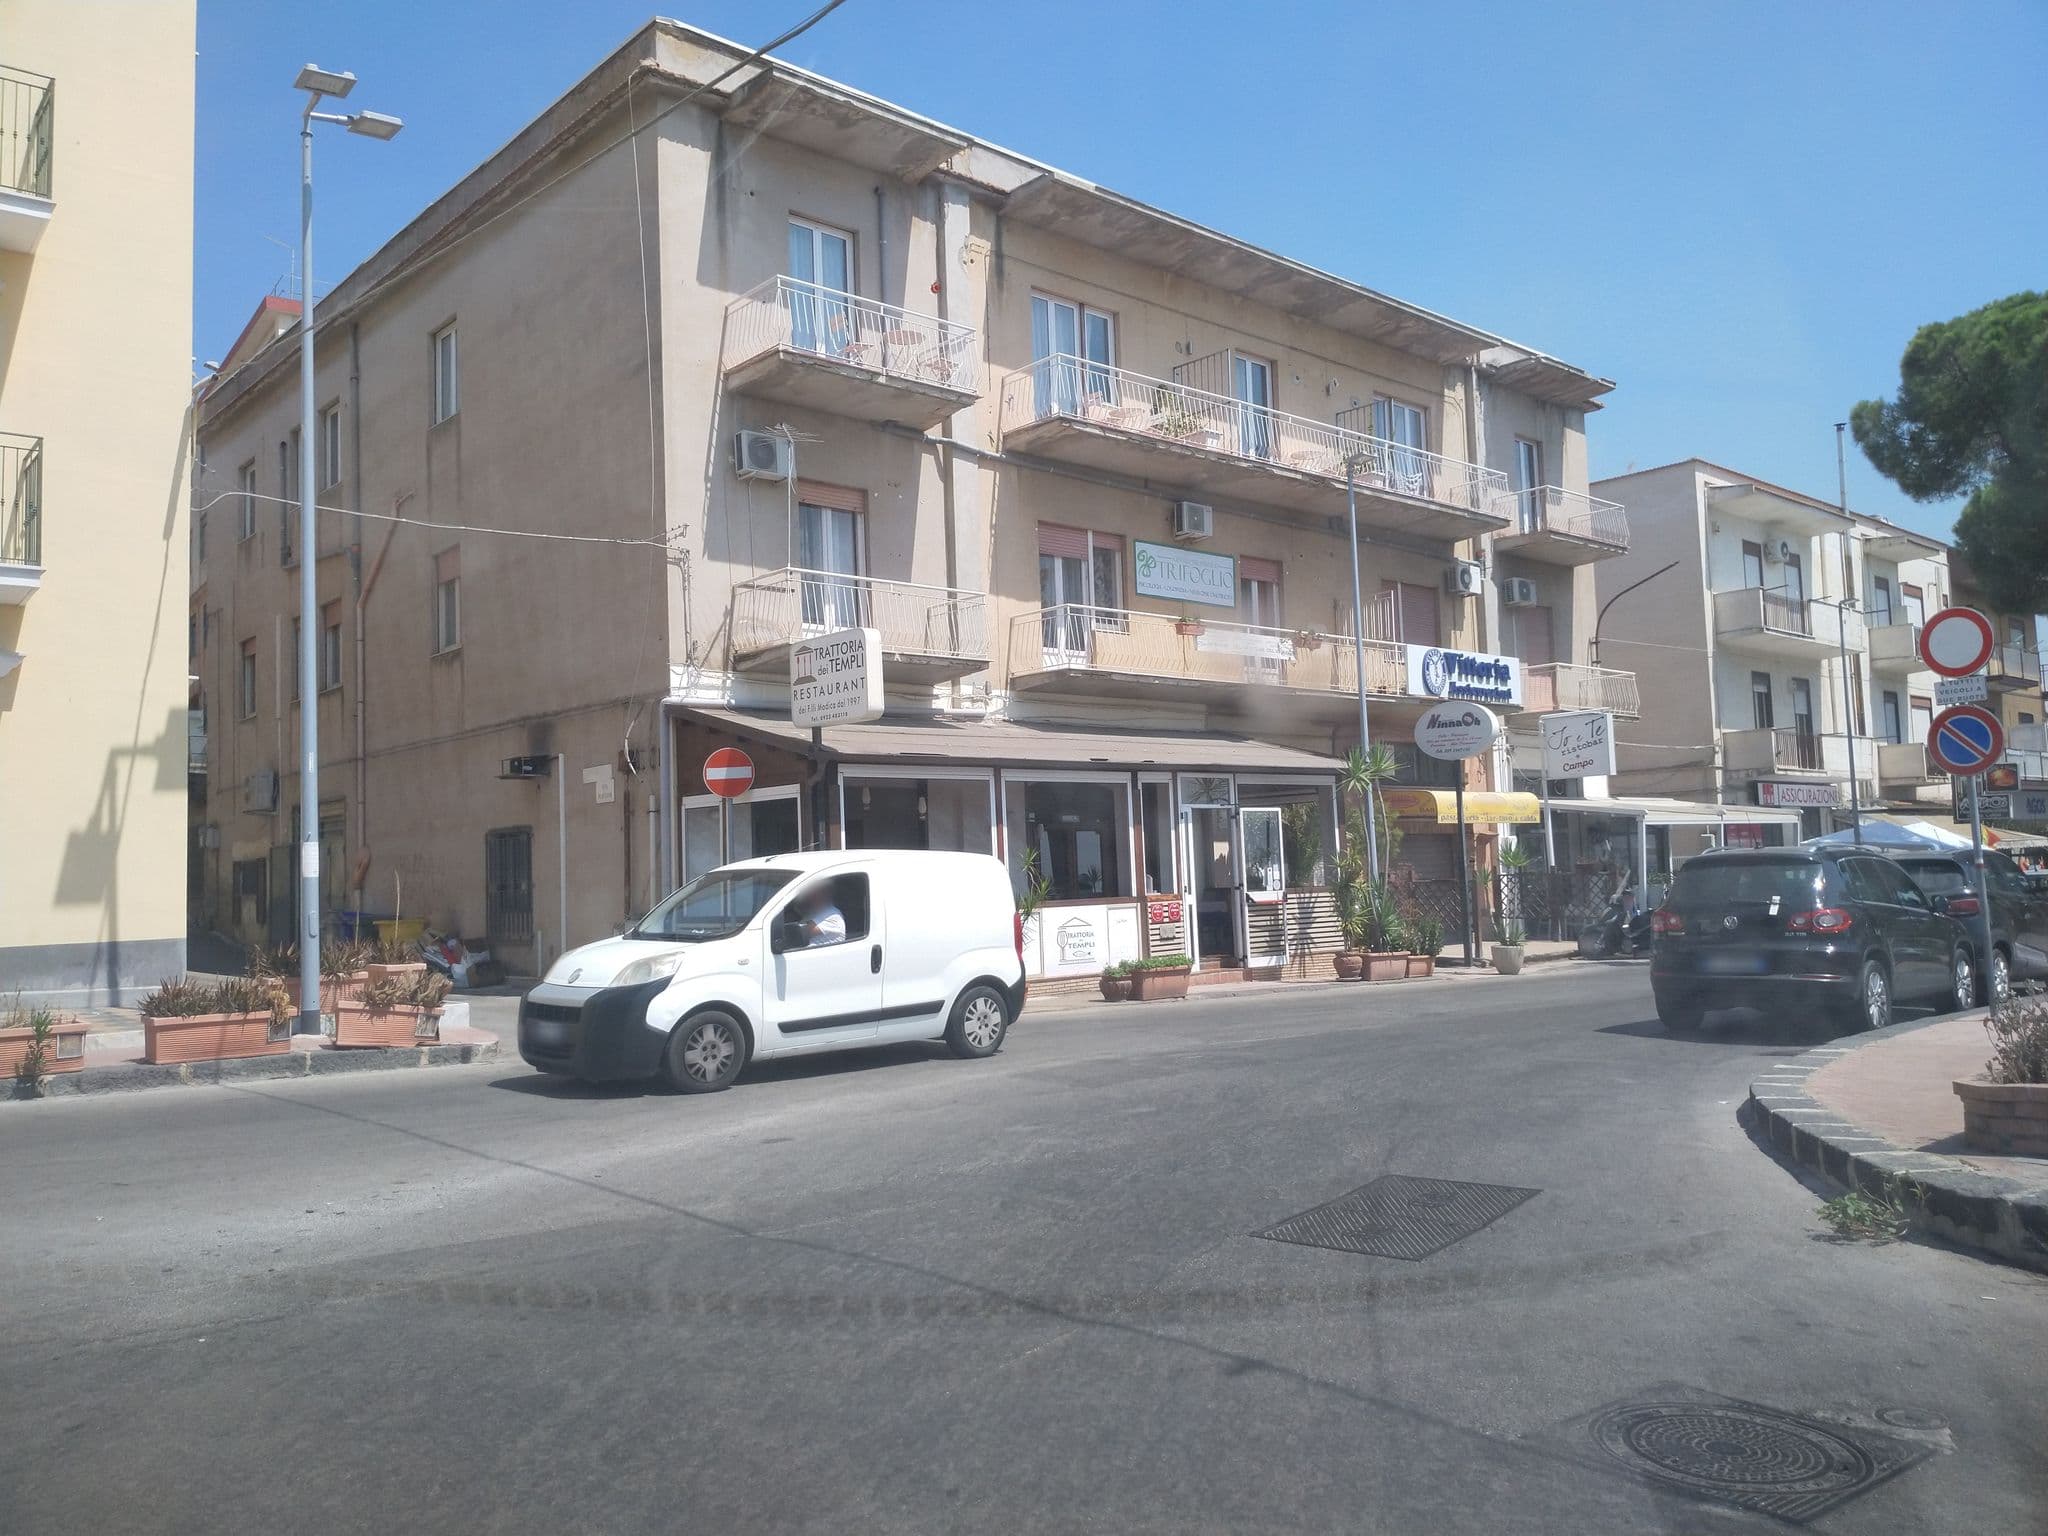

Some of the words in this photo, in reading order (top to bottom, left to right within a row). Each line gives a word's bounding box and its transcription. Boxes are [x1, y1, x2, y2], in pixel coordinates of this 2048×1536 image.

[1156, 561, 1233, 589] TRIFOGLIO
[814, 640, 864, 661] TRATTORIA
[818, 664, 829, 675] dei
[829, 653, 864, 673] TEMPLI
[1443, 652, 1511, 682] Vittoria
[793, 677, 865, 701] RESTAURANT
[1940, 687, 1973, 695] VEICOLI
[1561, 738, 1604, 756] ristobar
[1562, 759, 1594, 772] Campo
